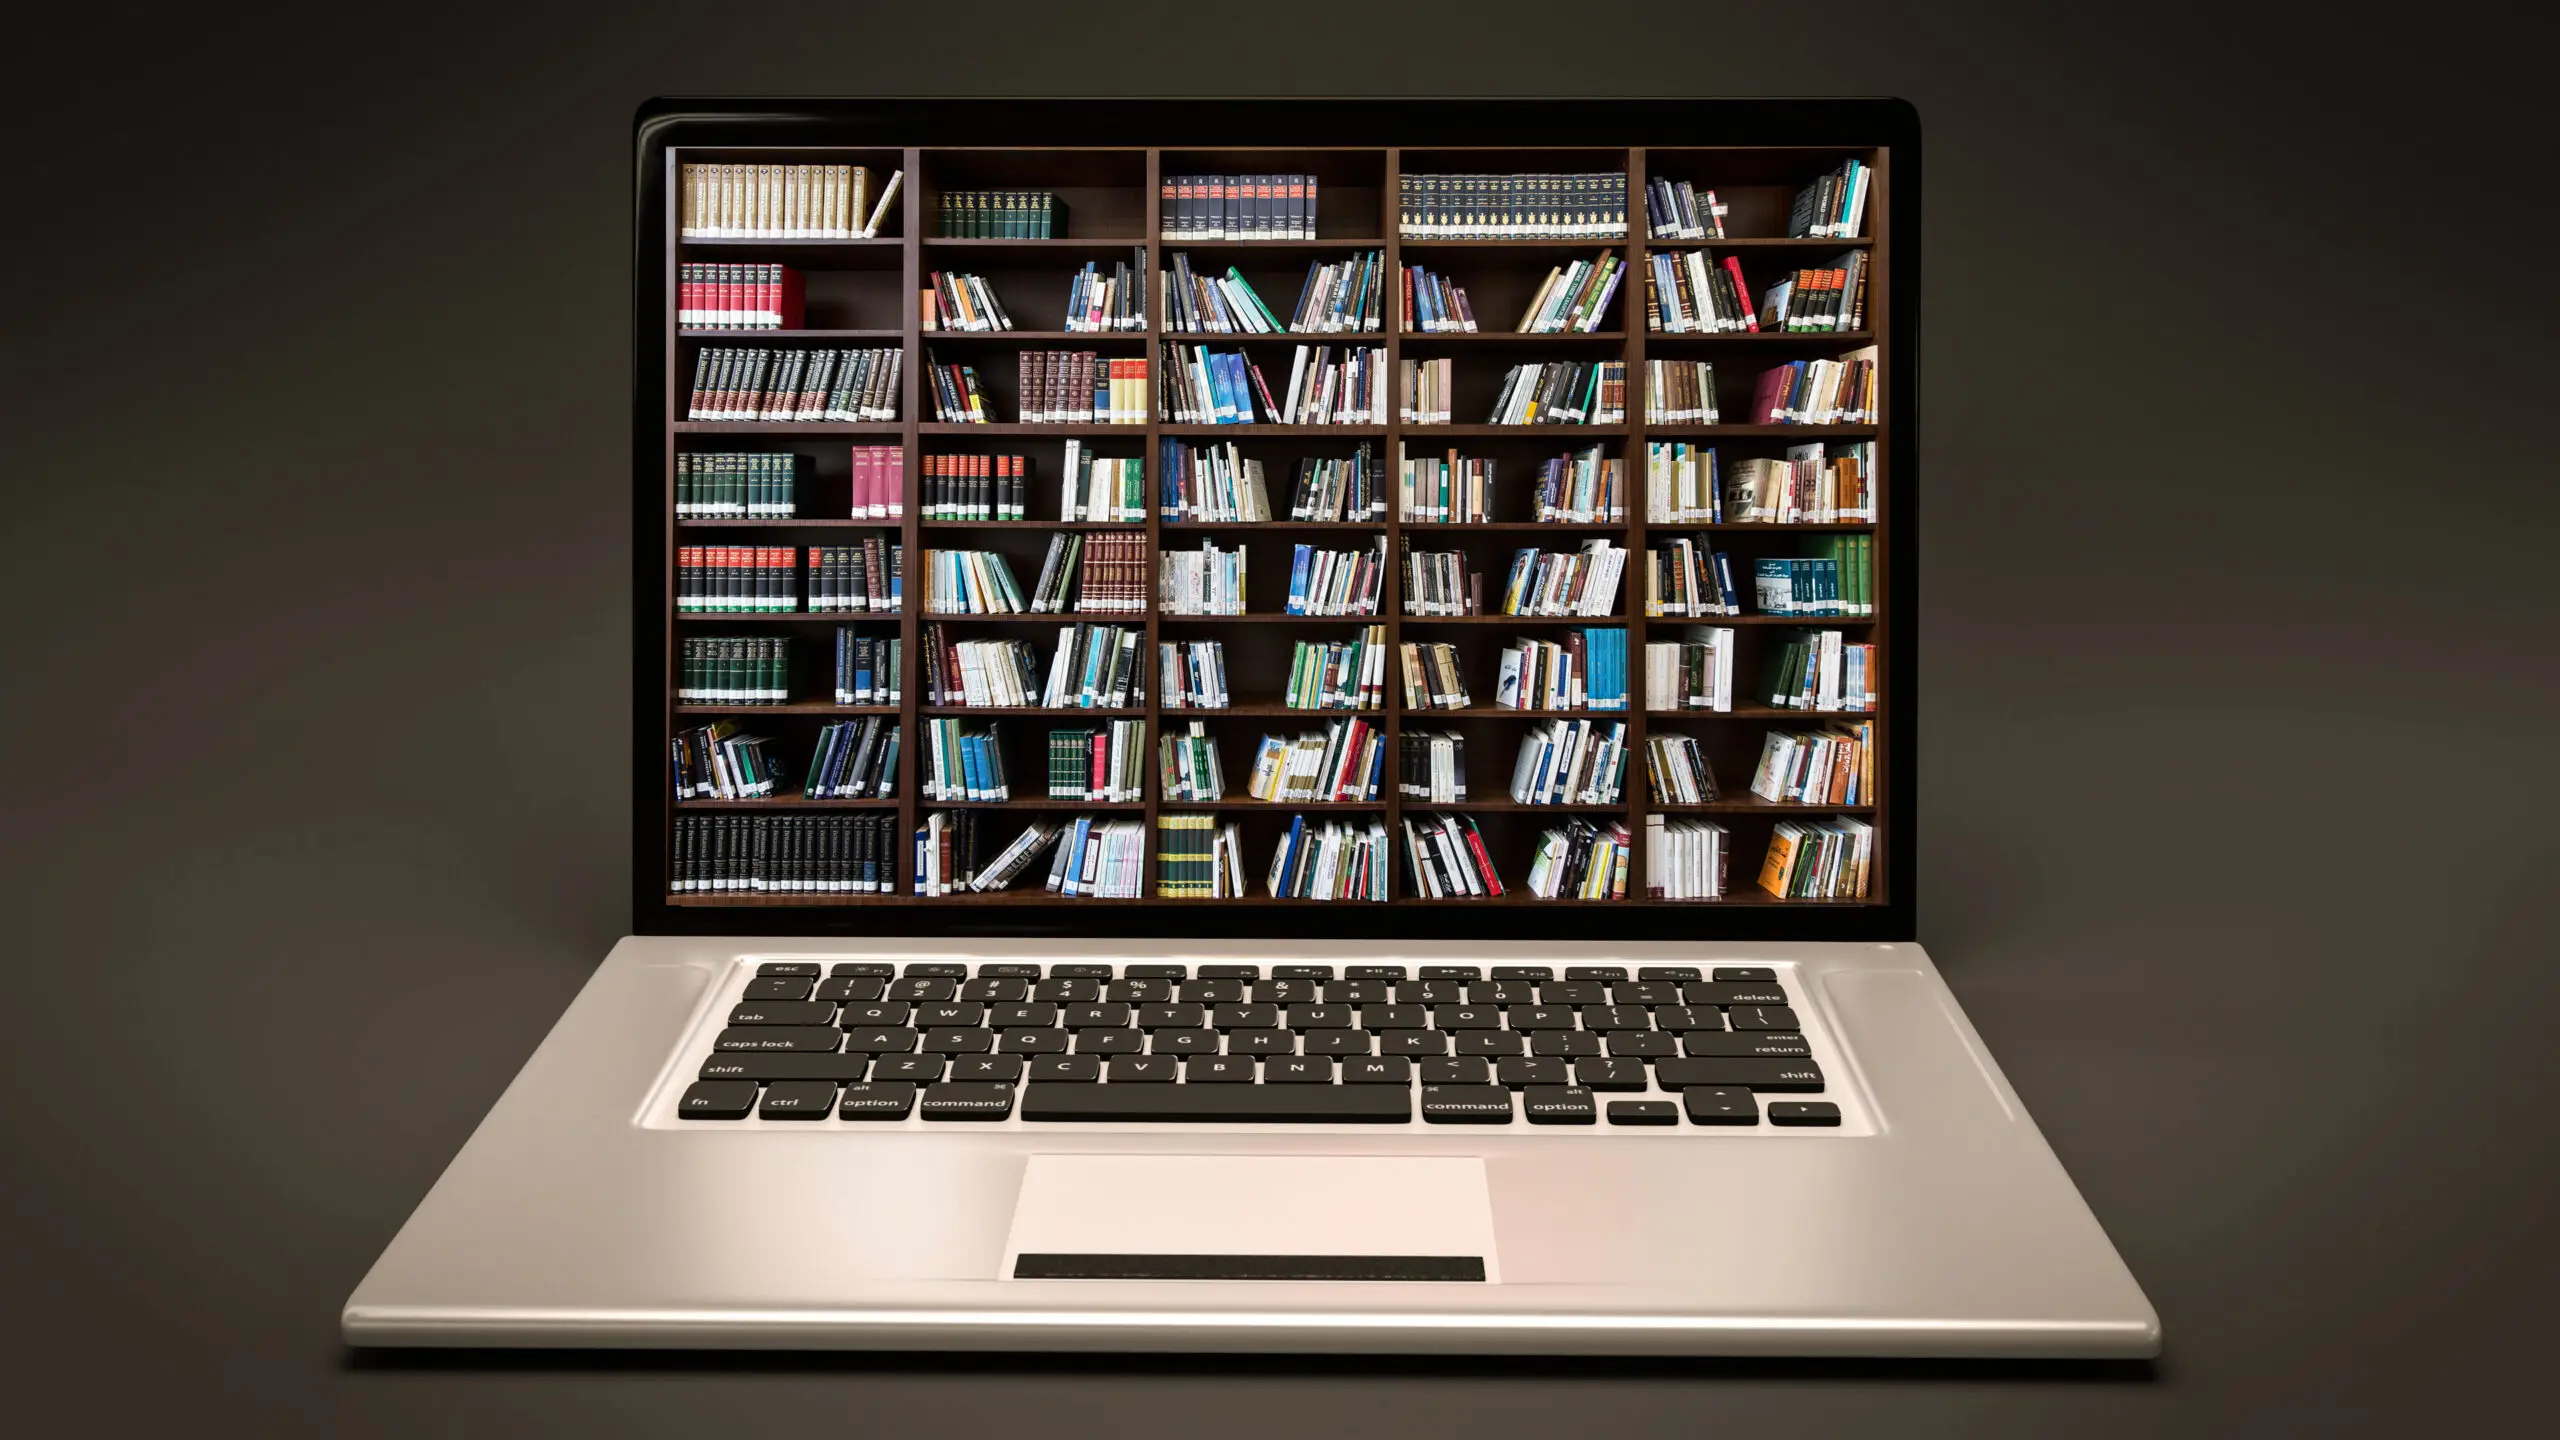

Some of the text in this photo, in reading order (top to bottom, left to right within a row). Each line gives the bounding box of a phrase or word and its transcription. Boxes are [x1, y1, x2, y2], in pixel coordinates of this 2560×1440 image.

[1332, 279, 1341, 298] DUBAI
[878, 538, 886, 556] ZAYED
[847, 979, 855, 988] !
[914, 980, 931, 989] @
[988, 980, 1001, 989] #
[1062, 979, 1073, 990] $
[1129, 980, 1148, 990] %
[1274, 981, 1290, 990] &
[1423, 981, 1431, 992] (
[1495, 982, 1503, 992] )
[843, 989, 851, 997] 1
[912, 989, 925, 997] 2
[985, 989, 997, 997] 3
[1059, 990, 1071, 998] 4
[1131, 990, 1143, 998] 5
[1276, 991, 1288, 999] 7
[1349, 991, 1361, 999] 8
[1421, 991, 1434, 999] 9
[866, 1008, 882, 1017] Q
[939, 1009, 959, 1017] W
[1016, 1009, 1028, 1018] E
[1089, 1010, 1102, 1018] R
[1164, 1010, 1177, 1018] T
[1237, 1010, 1251, 1019] Y
[1311, 1011, 1325, 1019] U
[1389, 1011, 1395, 1020] I
[1458, 1012, 1475, 1020] O
[1535, 1012, 1548, 1020] P
[1610, 1007, 1619, 1016] {
[1684, 1007, 1693, 1016] }
[1756, 1007, 1764, 1018] |
[738, 1013, 765, 1021] tab
[1613, 1016, 1621, 1025] [
[1688, 1016, 1696, 1026] ]
[1758, 1015, 1769, 1025] \
[873, 1034, 888, 1043] A
[951, 1035, 963, 1043] S
[1020, 1035, 1037, 1044] Q
[1102, 1035, 1114, 1044] F
[1176, 1036, 1192, 1044] G
[1253, 1036, 1269, 1045] H
[1331, 1036, 1341, 1045] J
[1407, 1037, 1421, 1045] K
[1483, 1037, 1495, 1046] L
[722, 1040, 794, 1049] caps lock
[900, 1061, 916, 1070] Z
[978, 1061, 993, 1070] X
[1056, 1062, 1071, 1071] C
[1134, 1062, 1149, 1071] V
[1213, 1063, 1226, 1072] B
[1289, 1063, 1305, 1072] N
[1366, 1064, 1385, 1073] M
[1446, 1060, 1460, 1068] <
[1604, 1060, 1614, 1069] ?
[707, 1065, 744, 1073] shift
[1608, 1070, 1616, 1079] /
[1779, 1071, 1817, 1079] shift
[691, 1097, 709, 1106] fn
[770, 1098, 800, 1107] ctrl
[843, 1099, 899, 1108] option
[923, 1099, 1006, 1107] command
[1532, 1103, 1589, 1112] option
